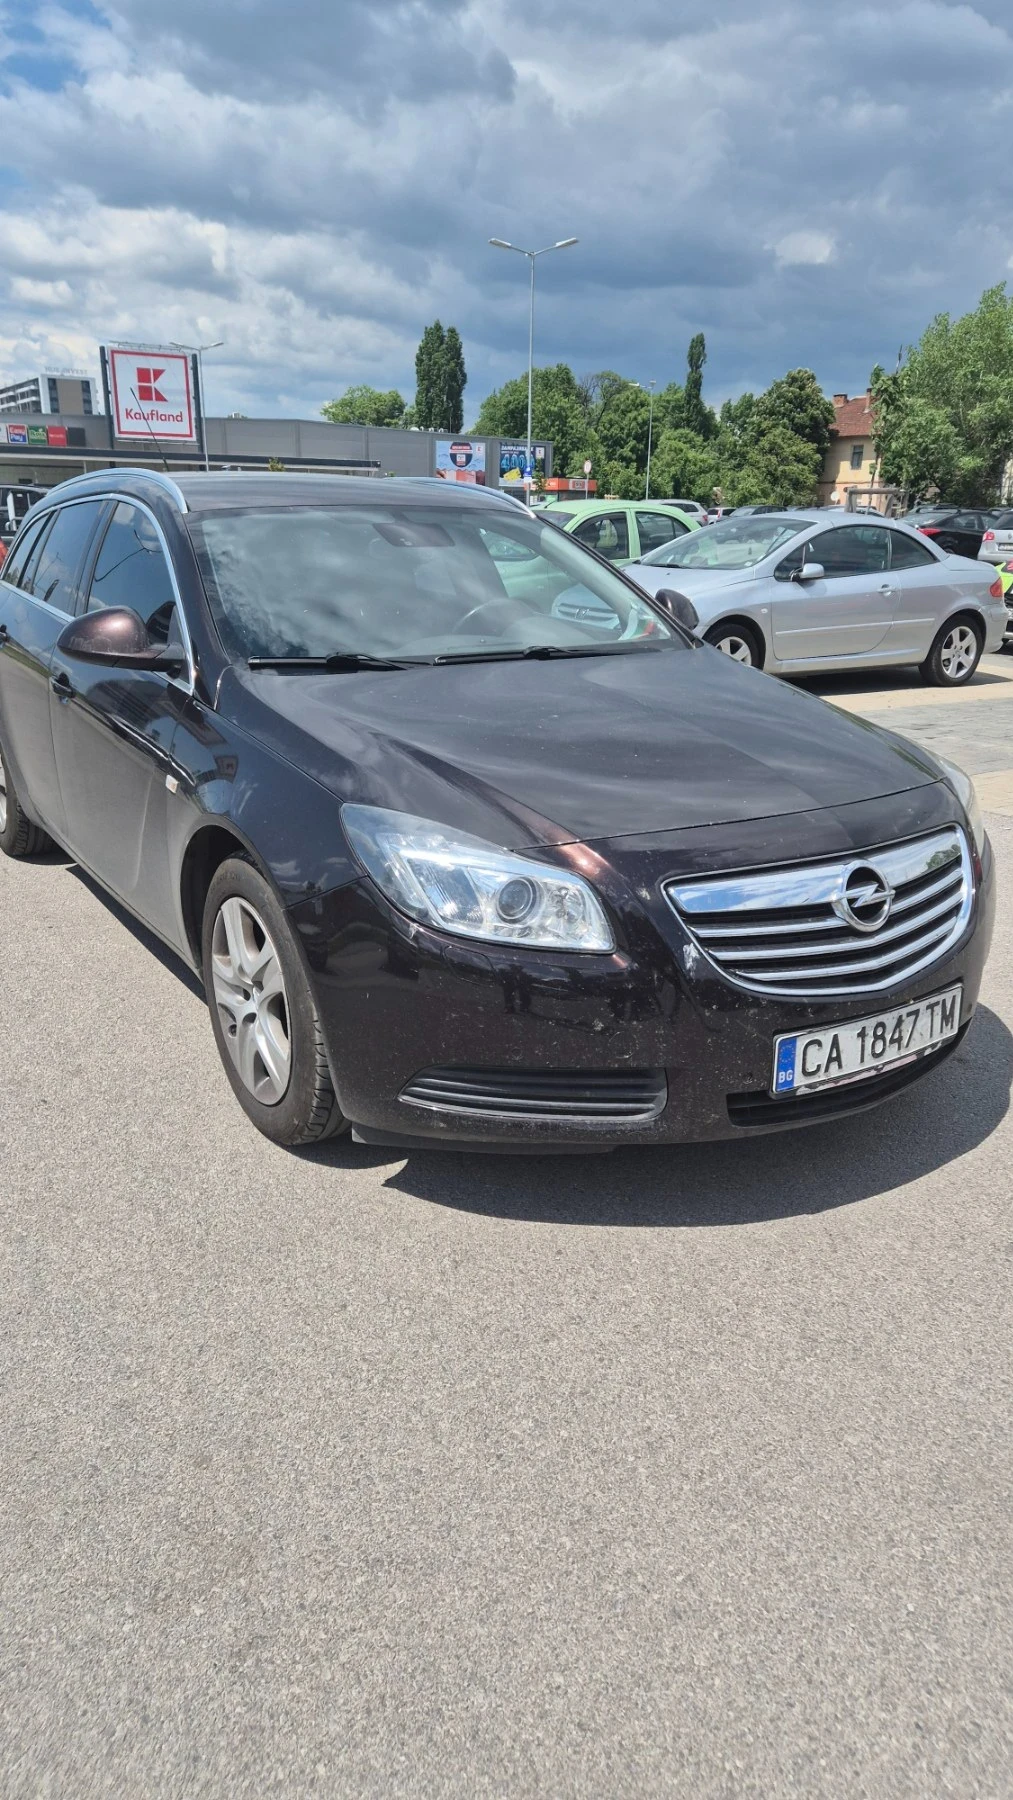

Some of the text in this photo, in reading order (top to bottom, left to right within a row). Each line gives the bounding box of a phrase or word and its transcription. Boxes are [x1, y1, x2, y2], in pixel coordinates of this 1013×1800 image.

[125, 408, 184, 423] Kaufland
[801, 995, 956, 1077] CA 1847 TM
[778, 1070, 793, 1083] BG
